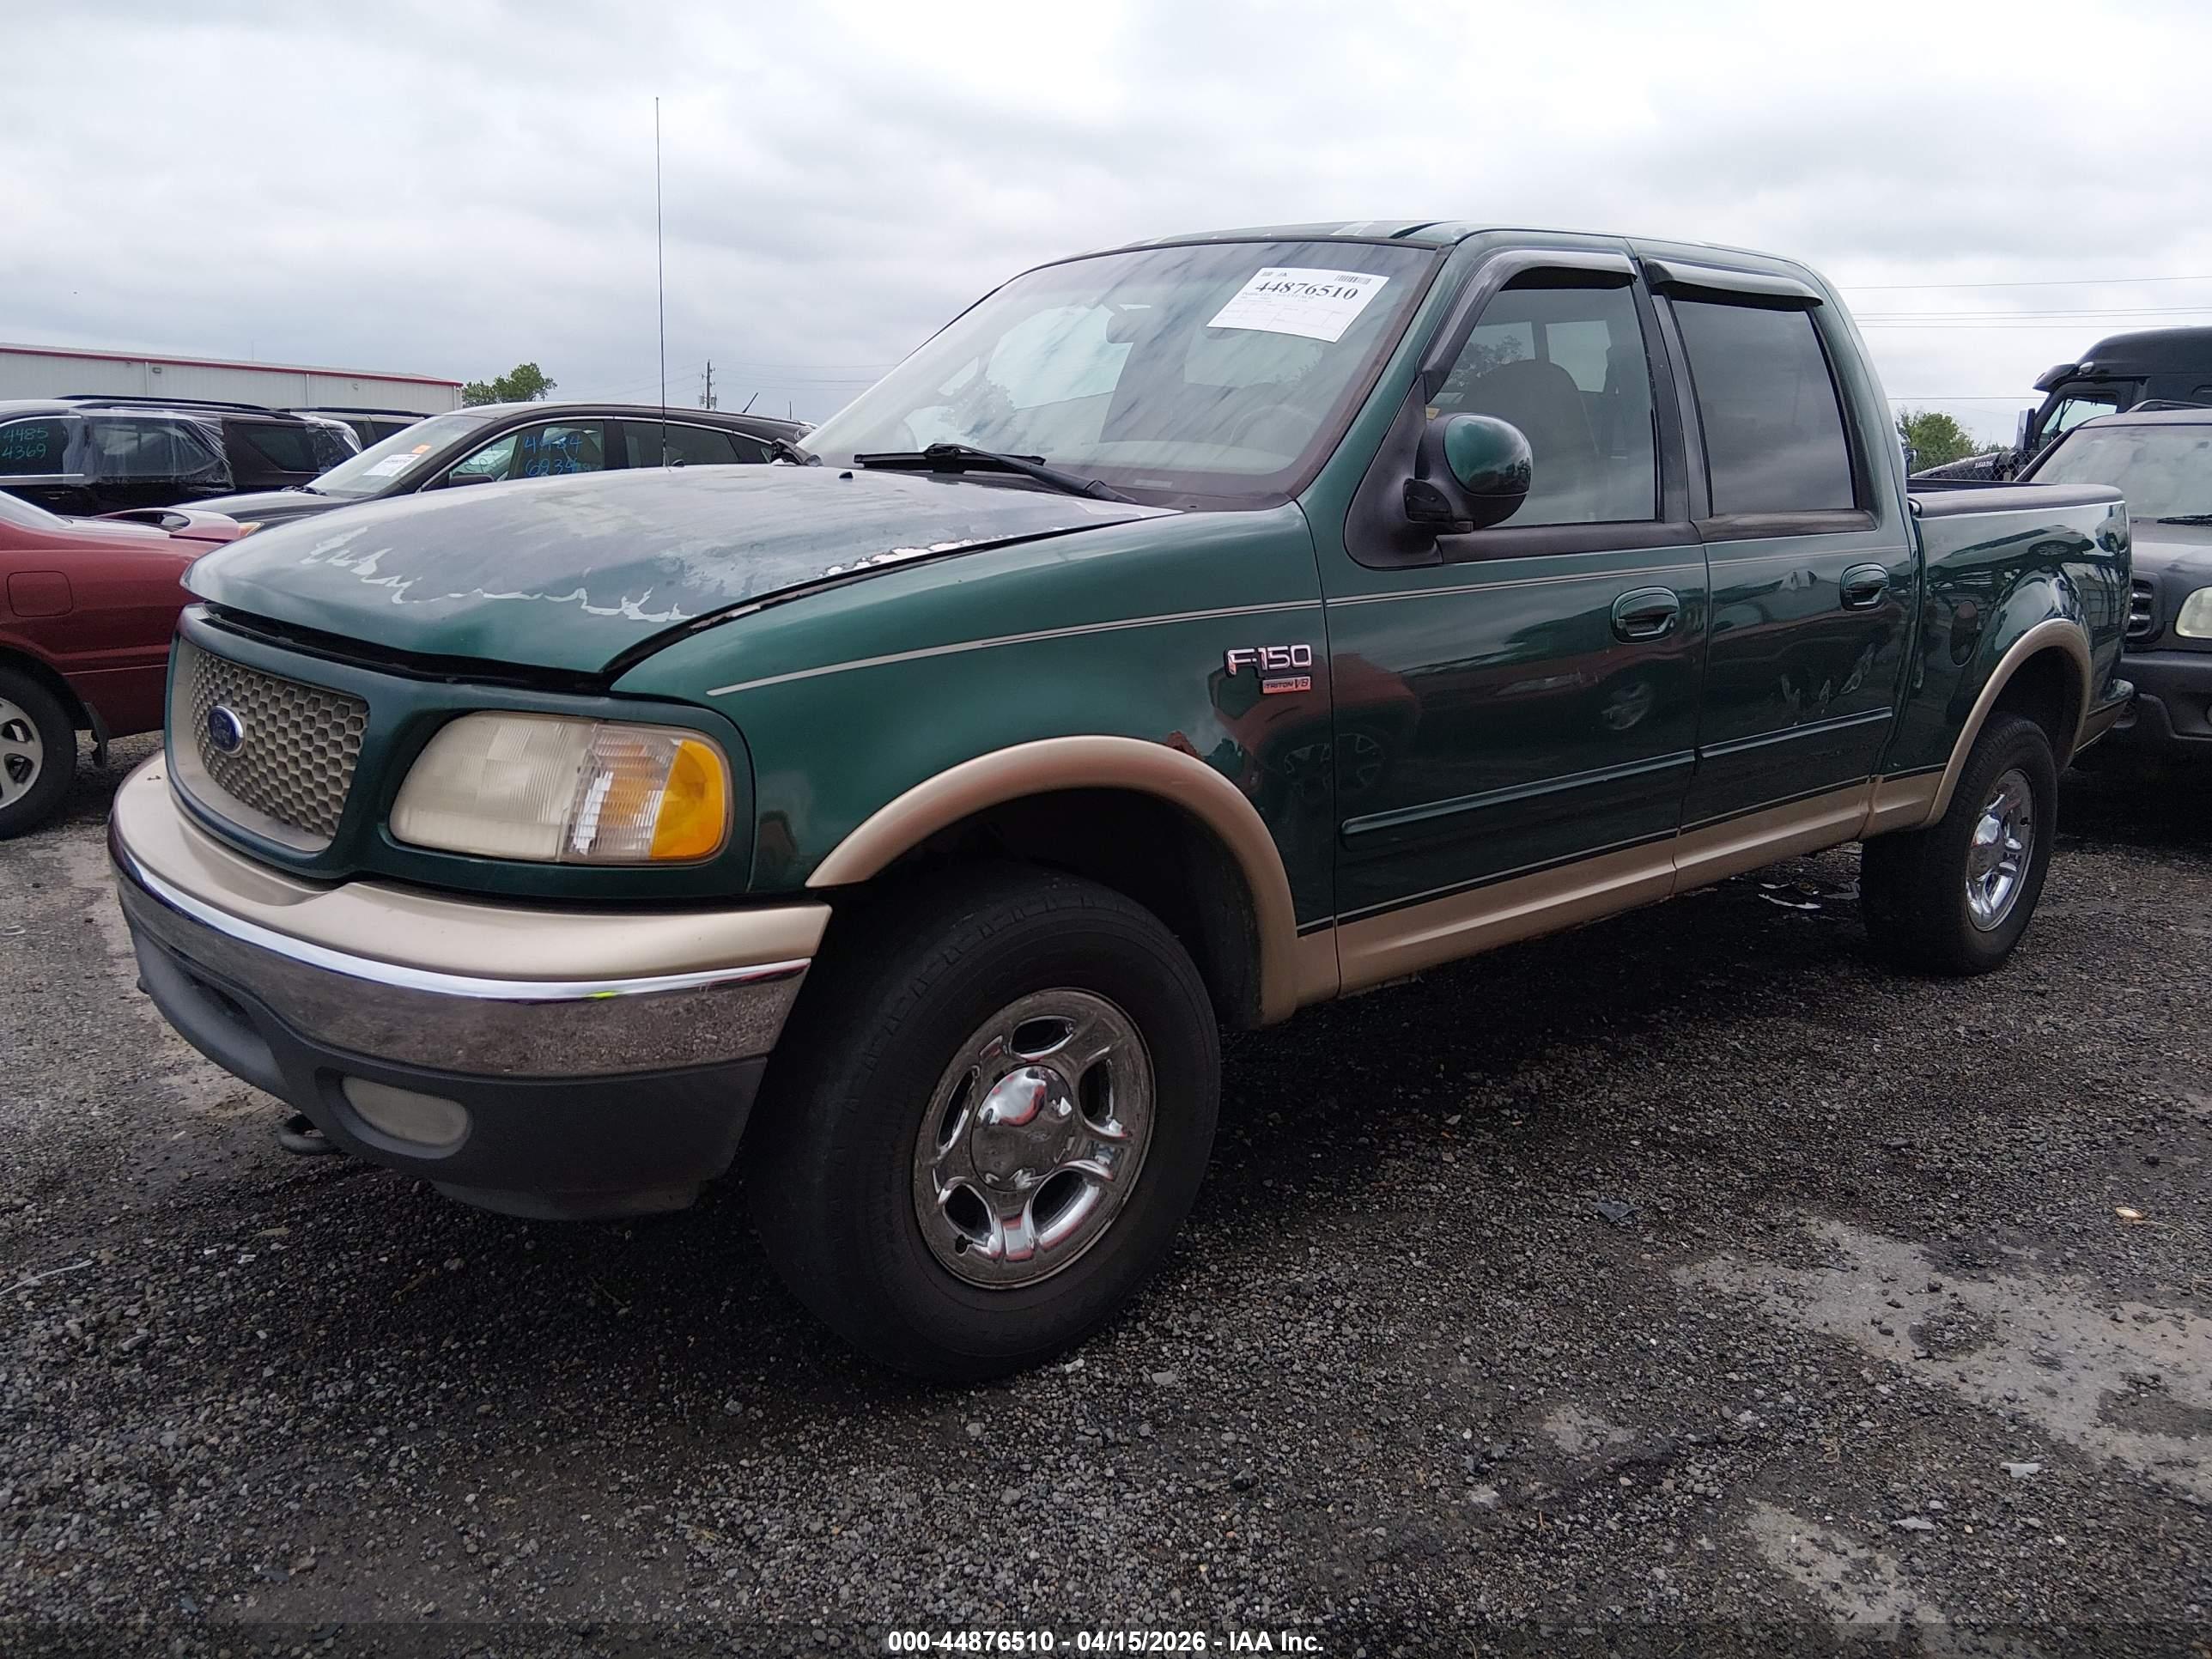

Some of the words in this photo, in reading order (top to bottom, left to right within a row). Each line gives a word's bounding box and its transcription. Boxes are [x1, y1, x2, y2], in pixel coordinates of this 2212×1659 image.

[1255, 281, 1358, 301] 44876510
[3, 427, 49, 442] 4485
[2, 443, 46, 459] 4369
[1226, 644, 1312, 676] F-150
[1294, 678, 1310, 689] V8
